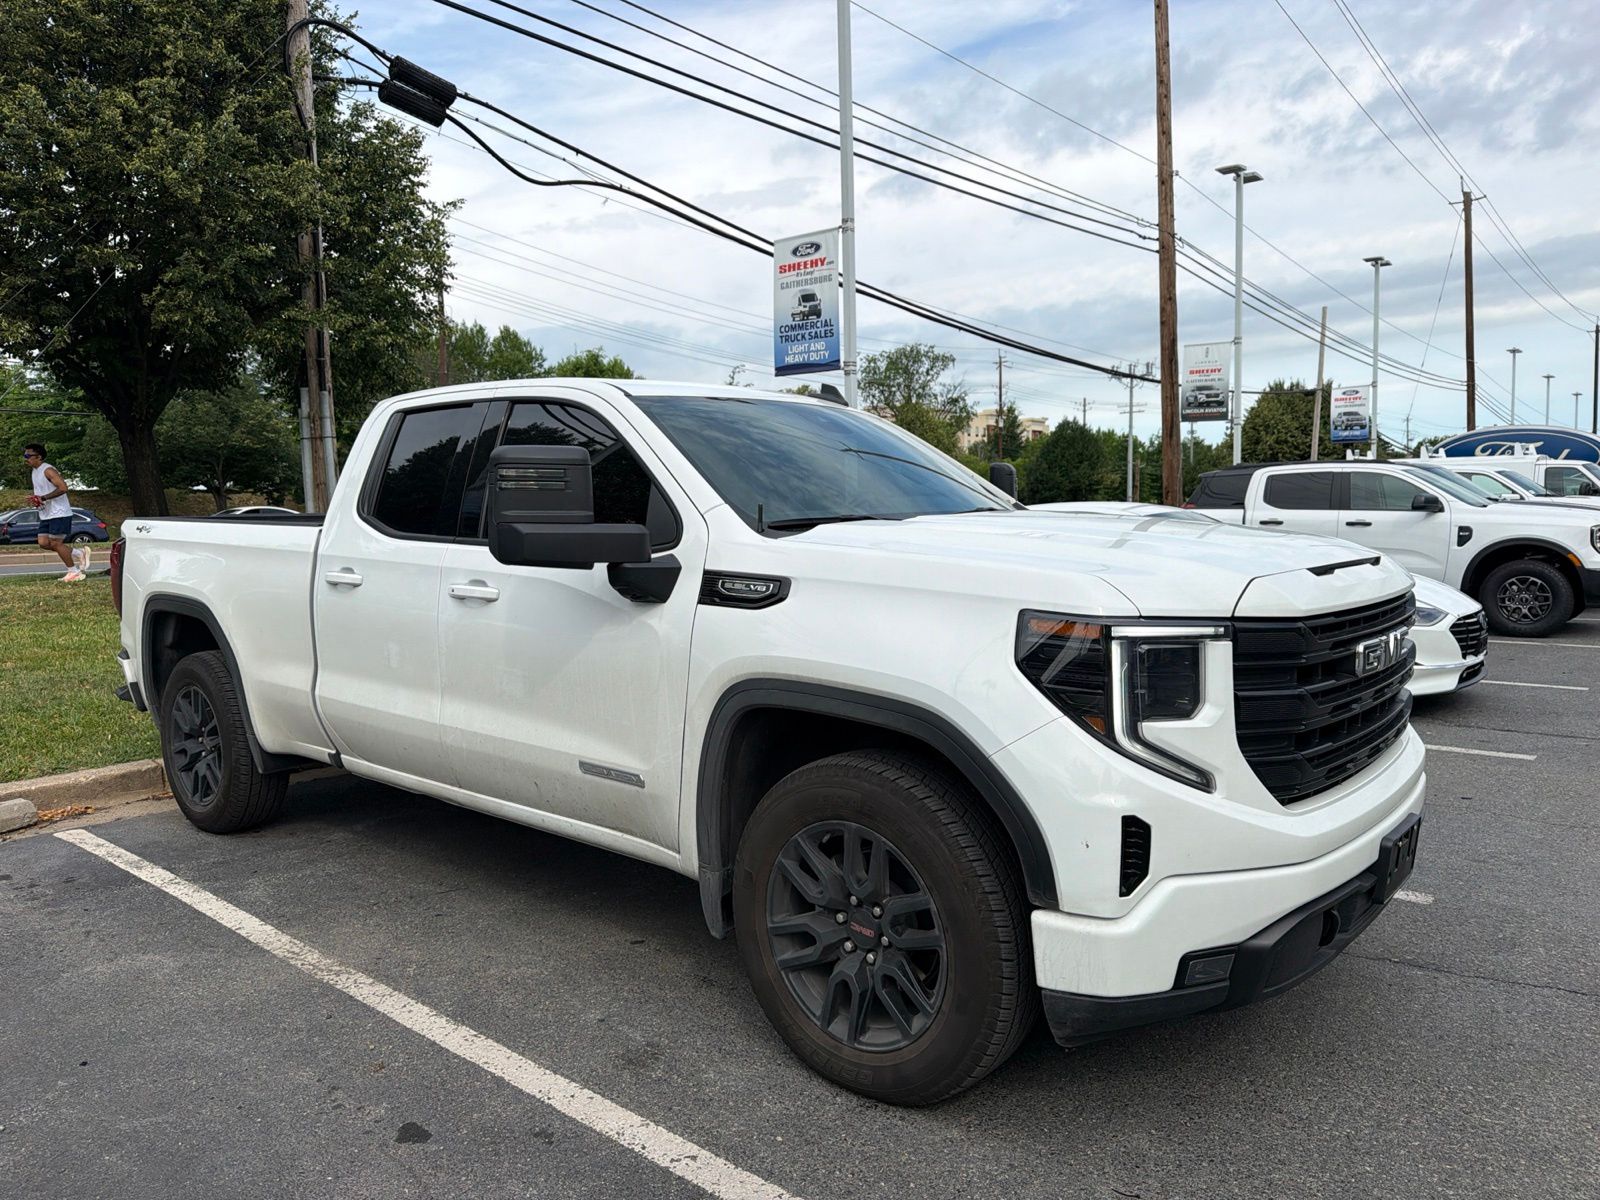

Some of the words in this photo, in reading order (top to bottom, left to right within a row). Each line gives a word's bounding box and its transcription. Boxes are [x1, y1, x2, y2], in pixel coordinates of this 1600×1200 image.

[778, 256, 827, 274] SHEEHY
[780, 274, 833, 290] GAITHERSBURG
[779, 318, 834, 334] COMMERCIAL
[779, 332, 807, 344] TRUCK
[808, 328, 834, 340] SALES
[788, 343, 809, 354] LIGHT
[810, 341, 826, 351] AND
[784, 353, 809, 364] HEAVY
[810, 350, 830, 361] DUTY
